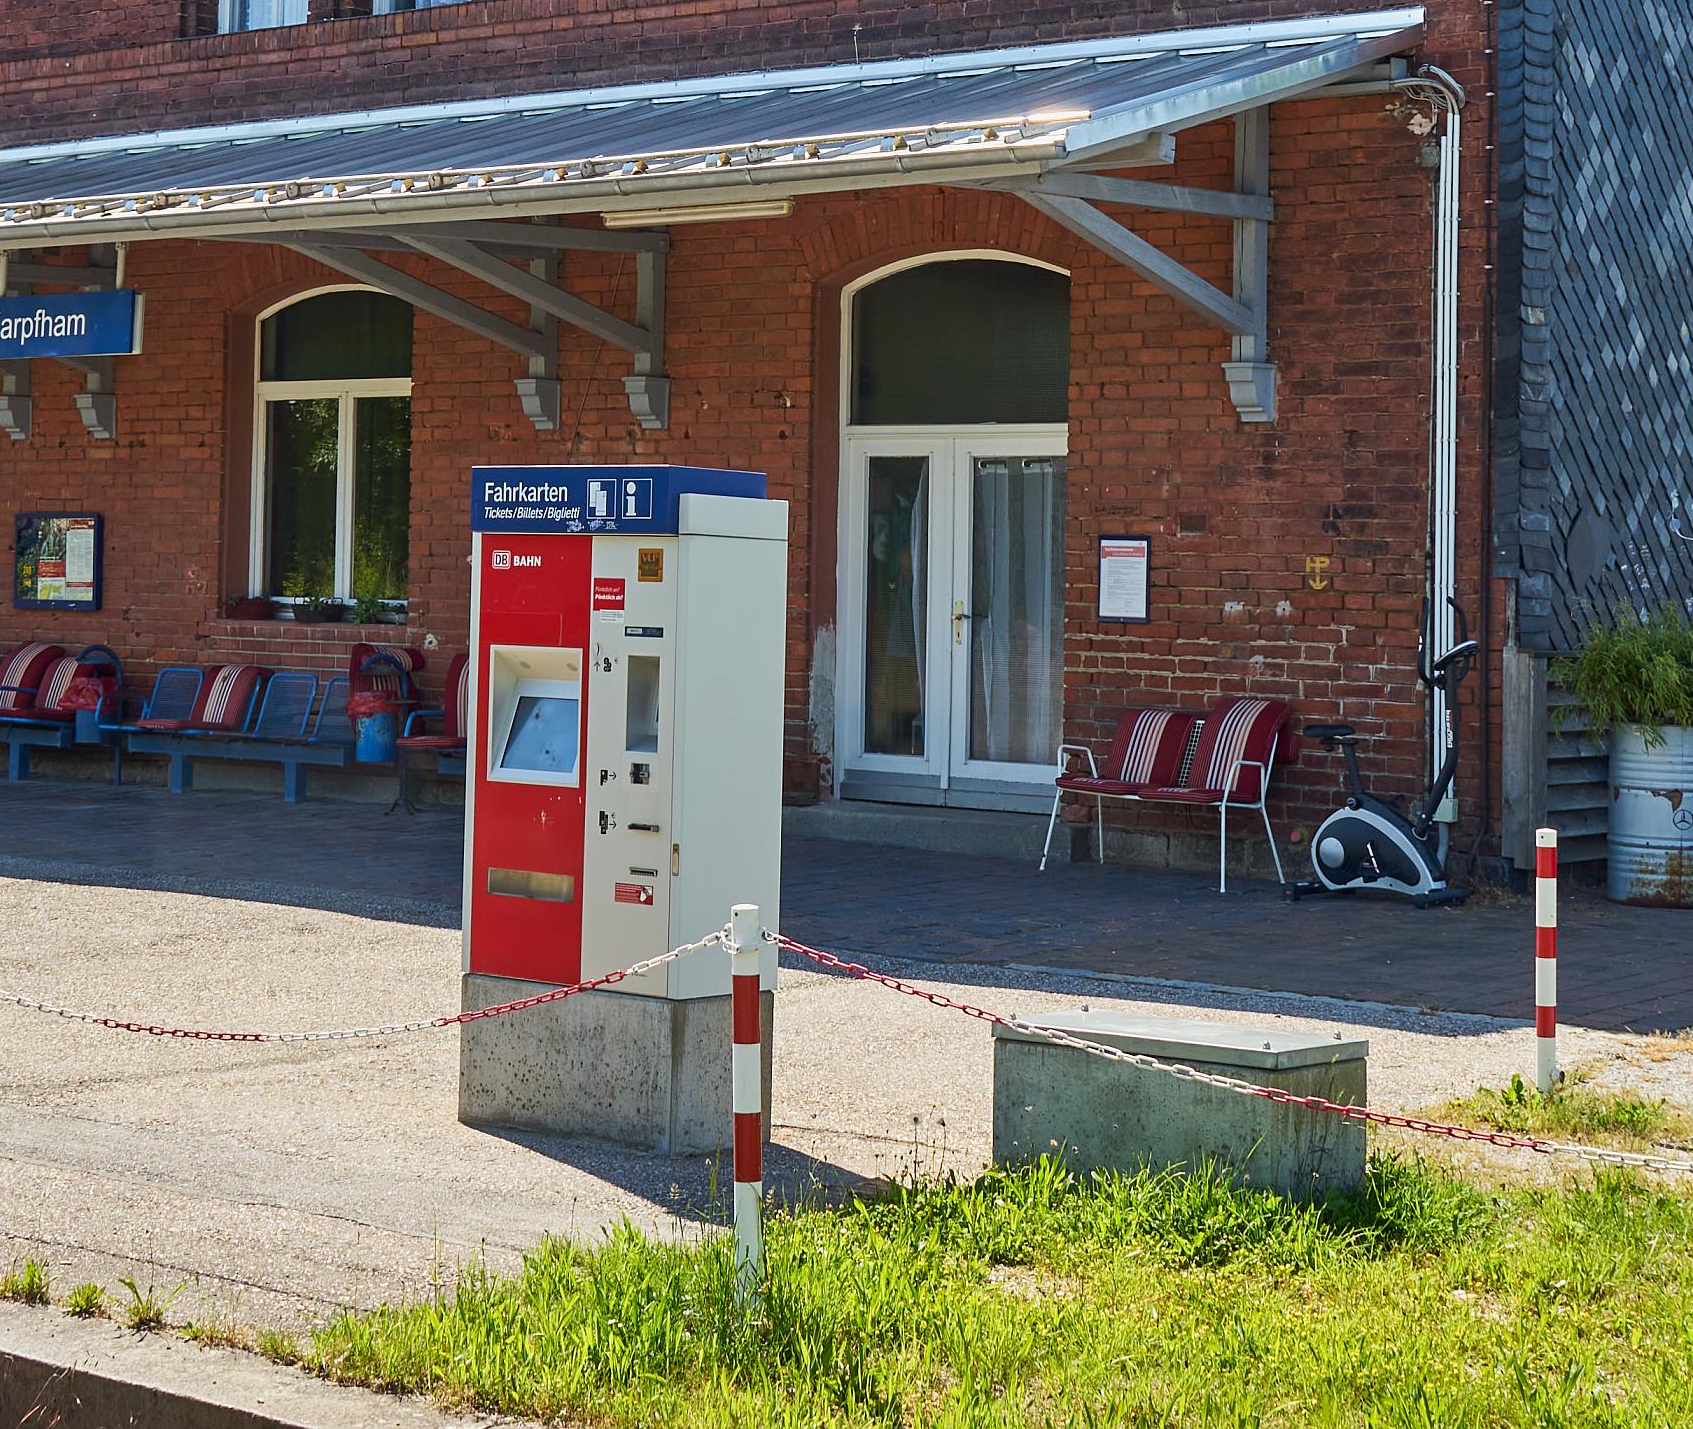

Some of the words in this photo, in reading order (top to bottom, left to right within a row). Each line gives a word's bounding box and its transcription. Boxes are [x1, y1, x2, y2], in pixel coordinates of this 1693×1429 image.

[484, 482, 568, 502] Fahrkarten
[484, 506, 581, 521] Tickets/Billets/Biglietti
[513, 555, 542, 567] BAHN
